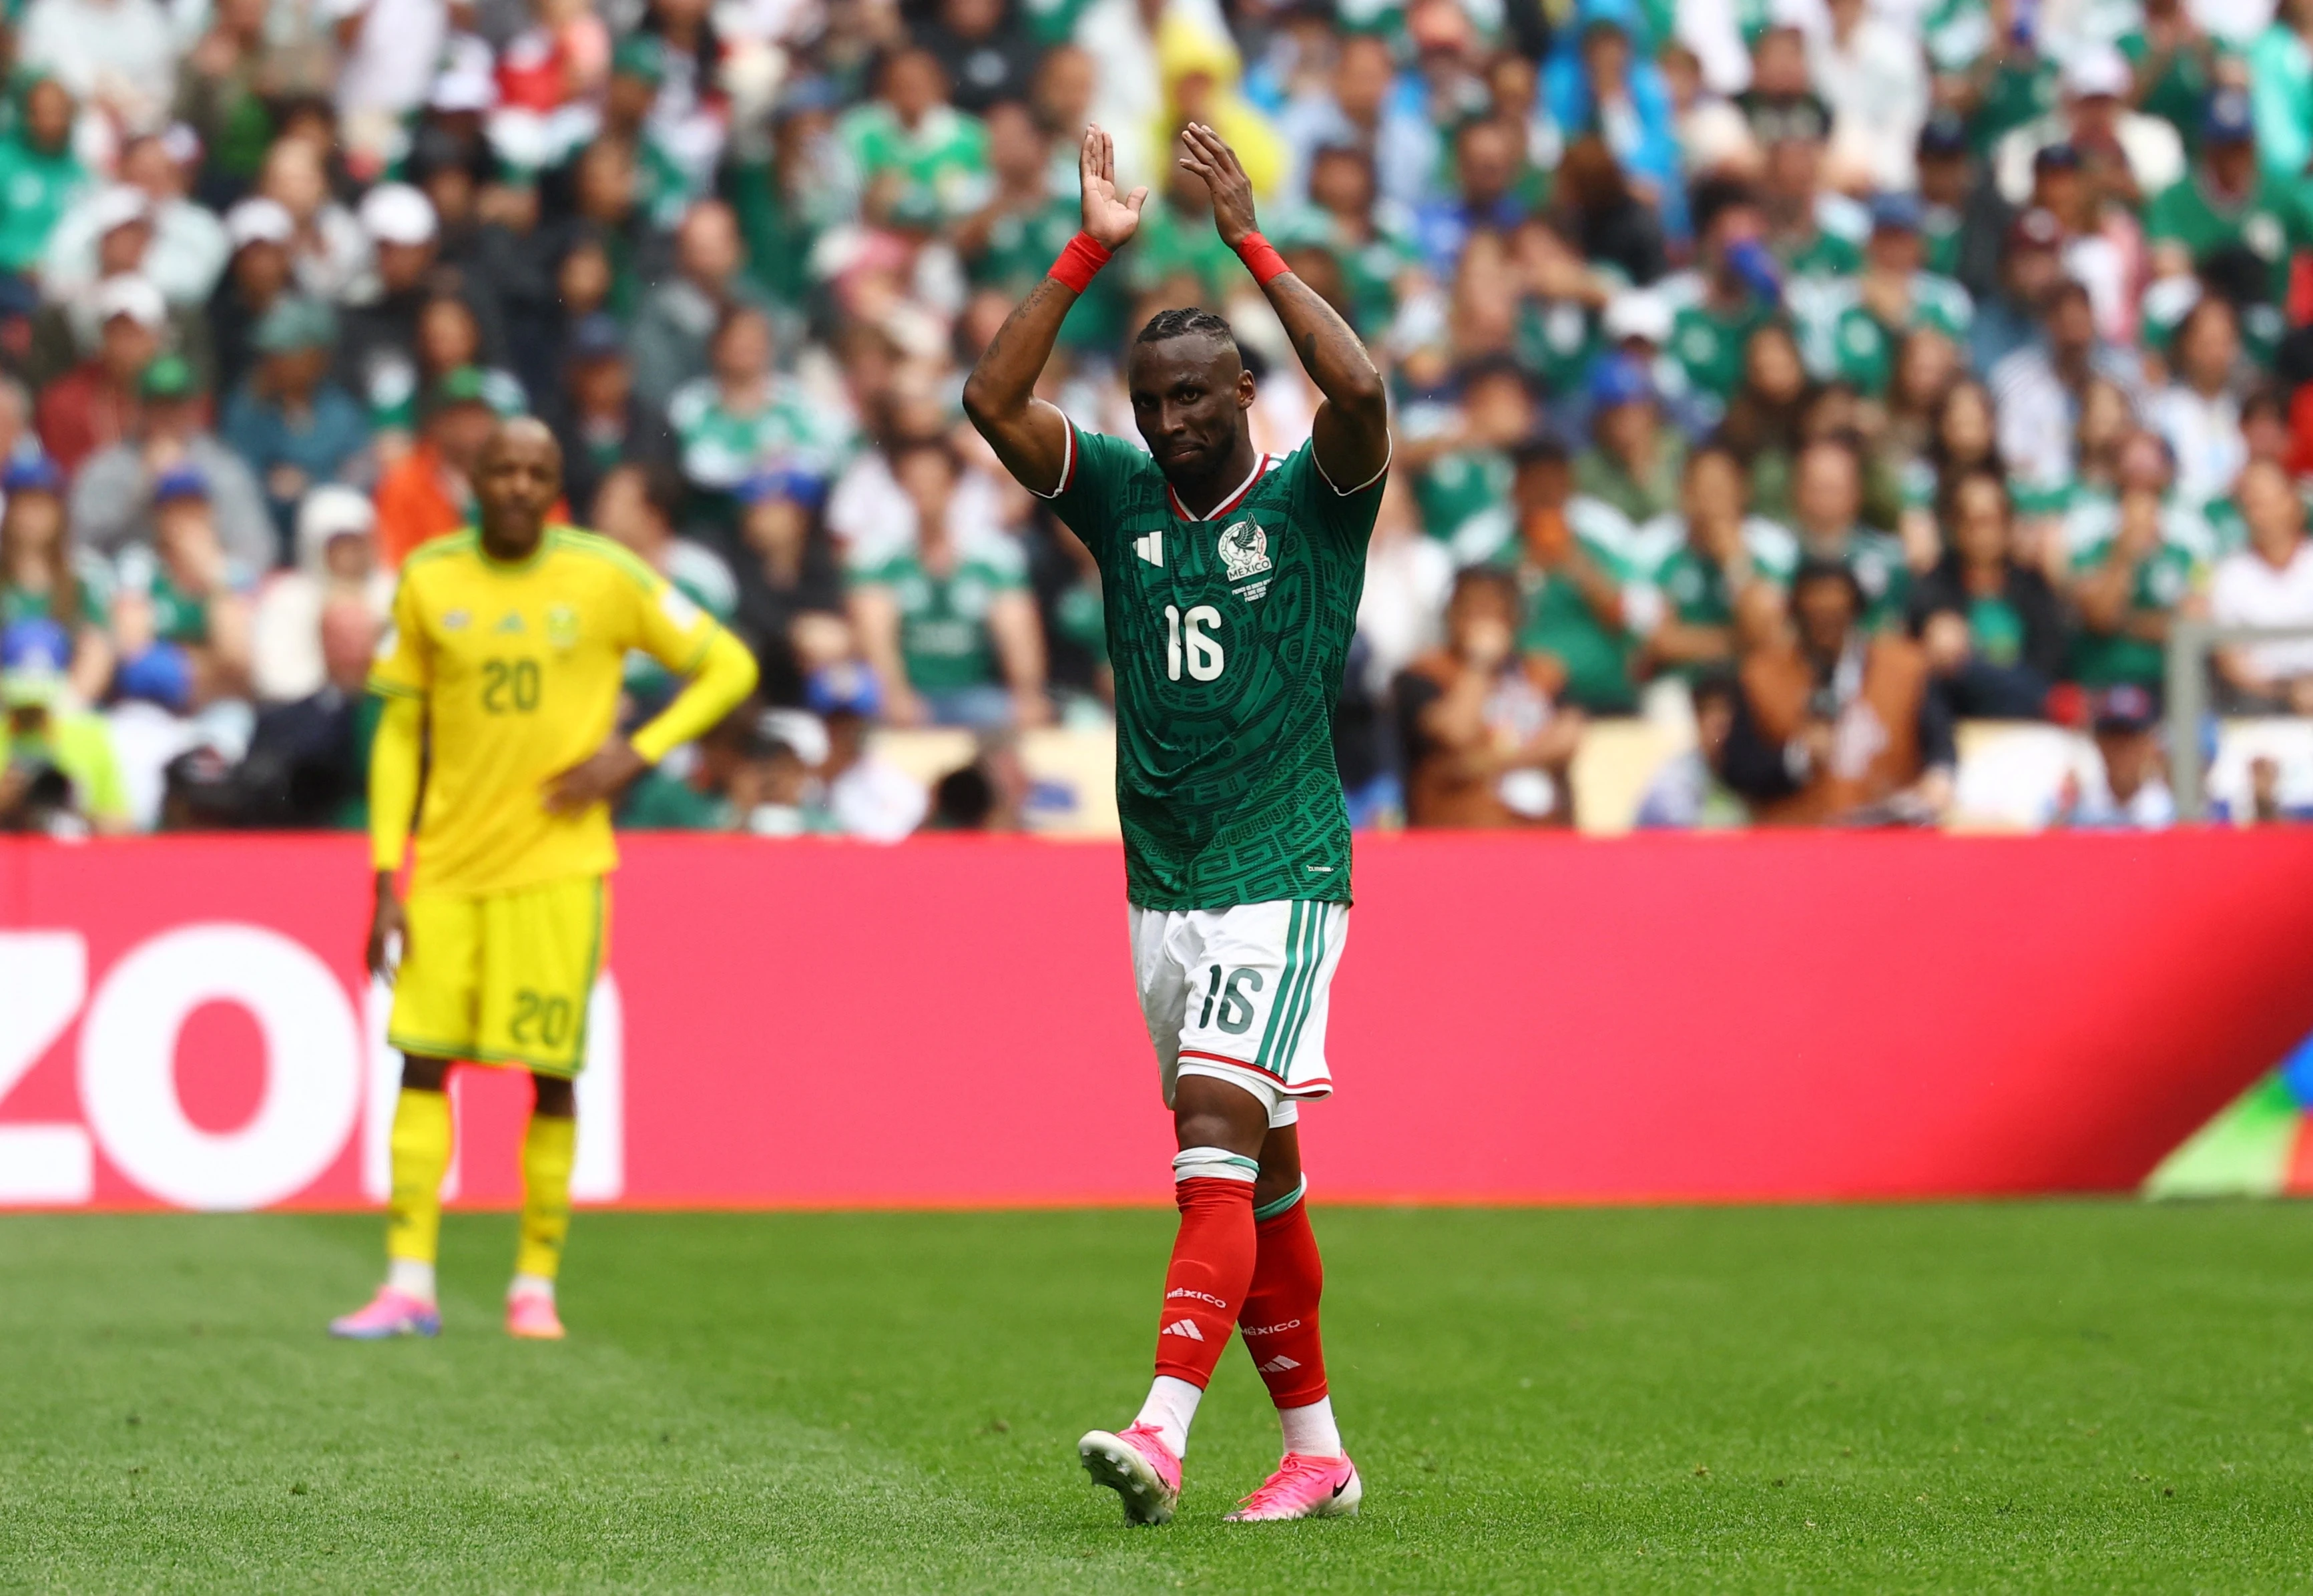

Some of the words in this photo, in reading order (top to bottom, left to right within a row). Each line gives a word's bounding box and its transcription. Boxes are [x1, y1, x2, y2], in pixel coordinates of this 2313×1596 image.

[1228, 560, 1270, 580] MÉXICO
[1164, 604, 1225, 682] 16
[481, 659, 542, 716] 20
[509, 988, 573, 1049] 20
[1198, 964, 1264, 1035] 16
[1167, 1287, 1227, 1308] MÉXICO
[1241, 1319, 1301, 1336] MÉXICO
